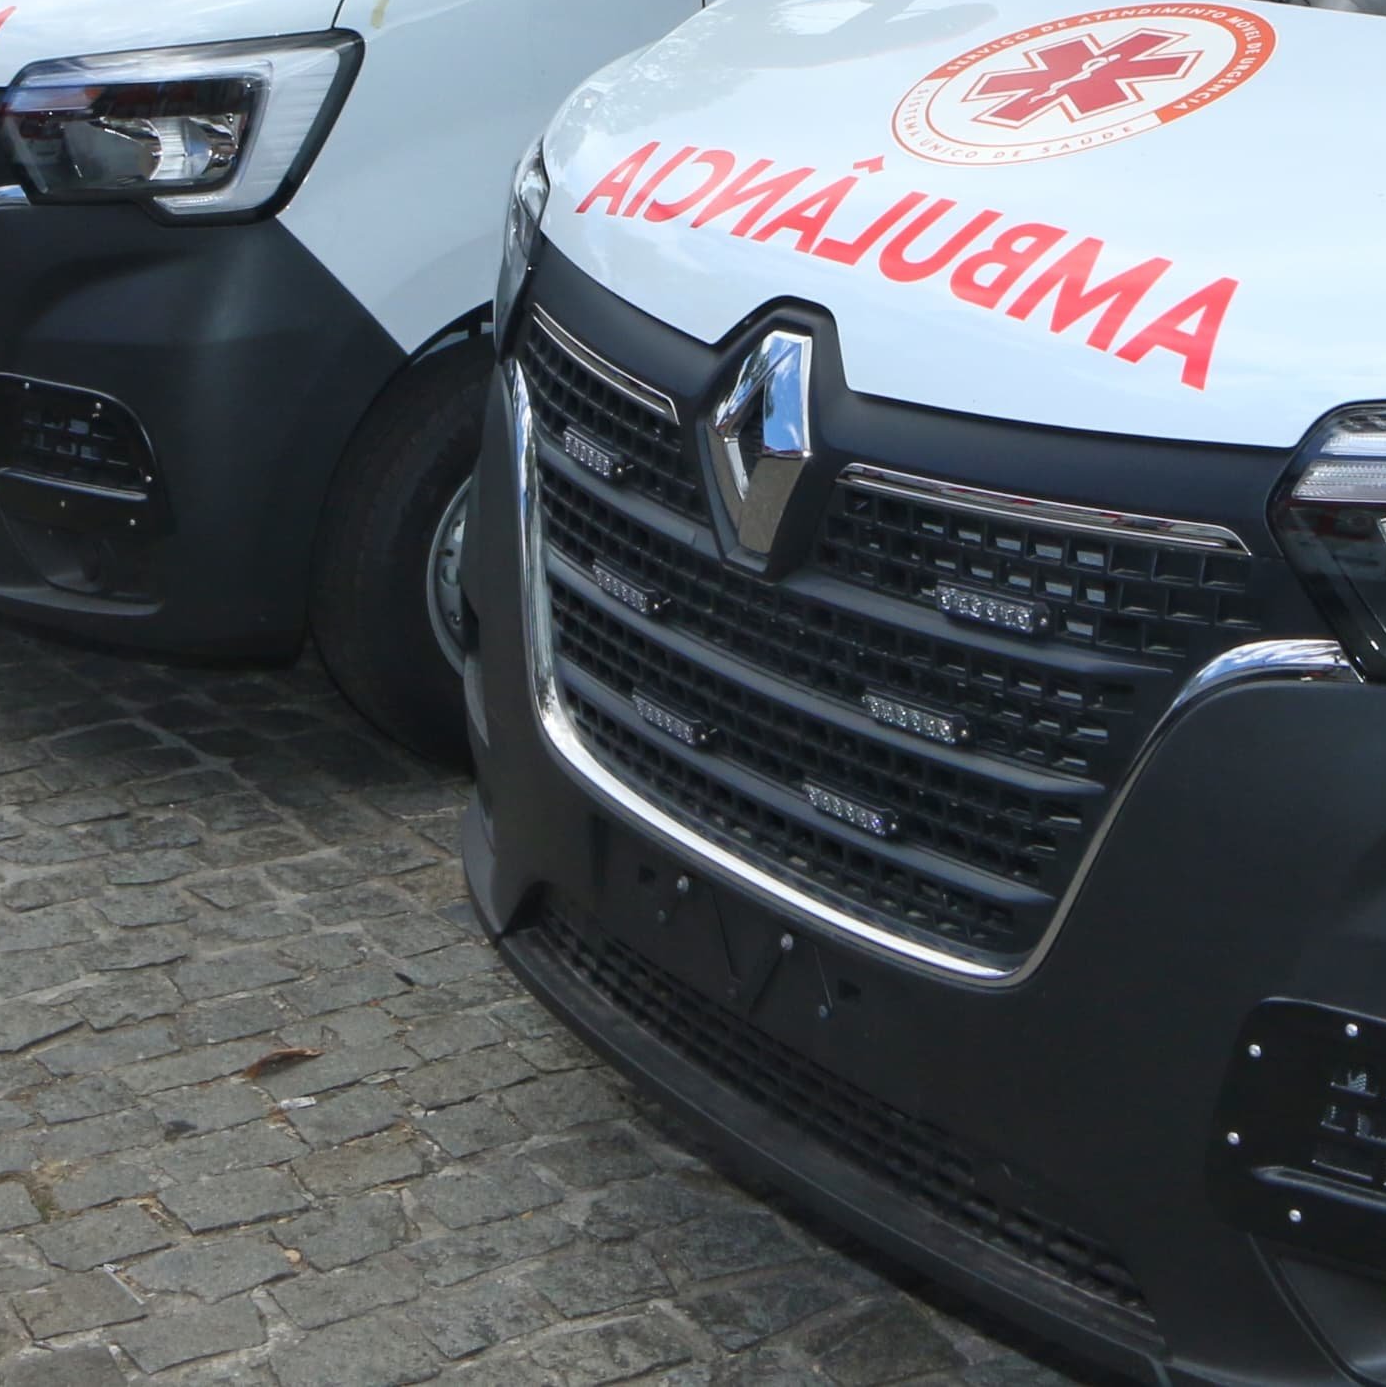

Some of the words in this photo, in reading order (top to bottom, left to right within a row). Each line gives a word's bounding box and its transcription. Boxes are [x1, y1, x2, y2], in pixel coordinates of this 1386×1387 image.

[1076, 6, 1230, 22] ATENDIMENTO
[1040, 21, 1068, 33] DE
[1225, 17, 1263, 42] MÓVEL
[1245, 41, 1263, 55] DE
[1173, 55, 1260, 111] URGÊNCIA
[992, 149, 1023, 160] DE
